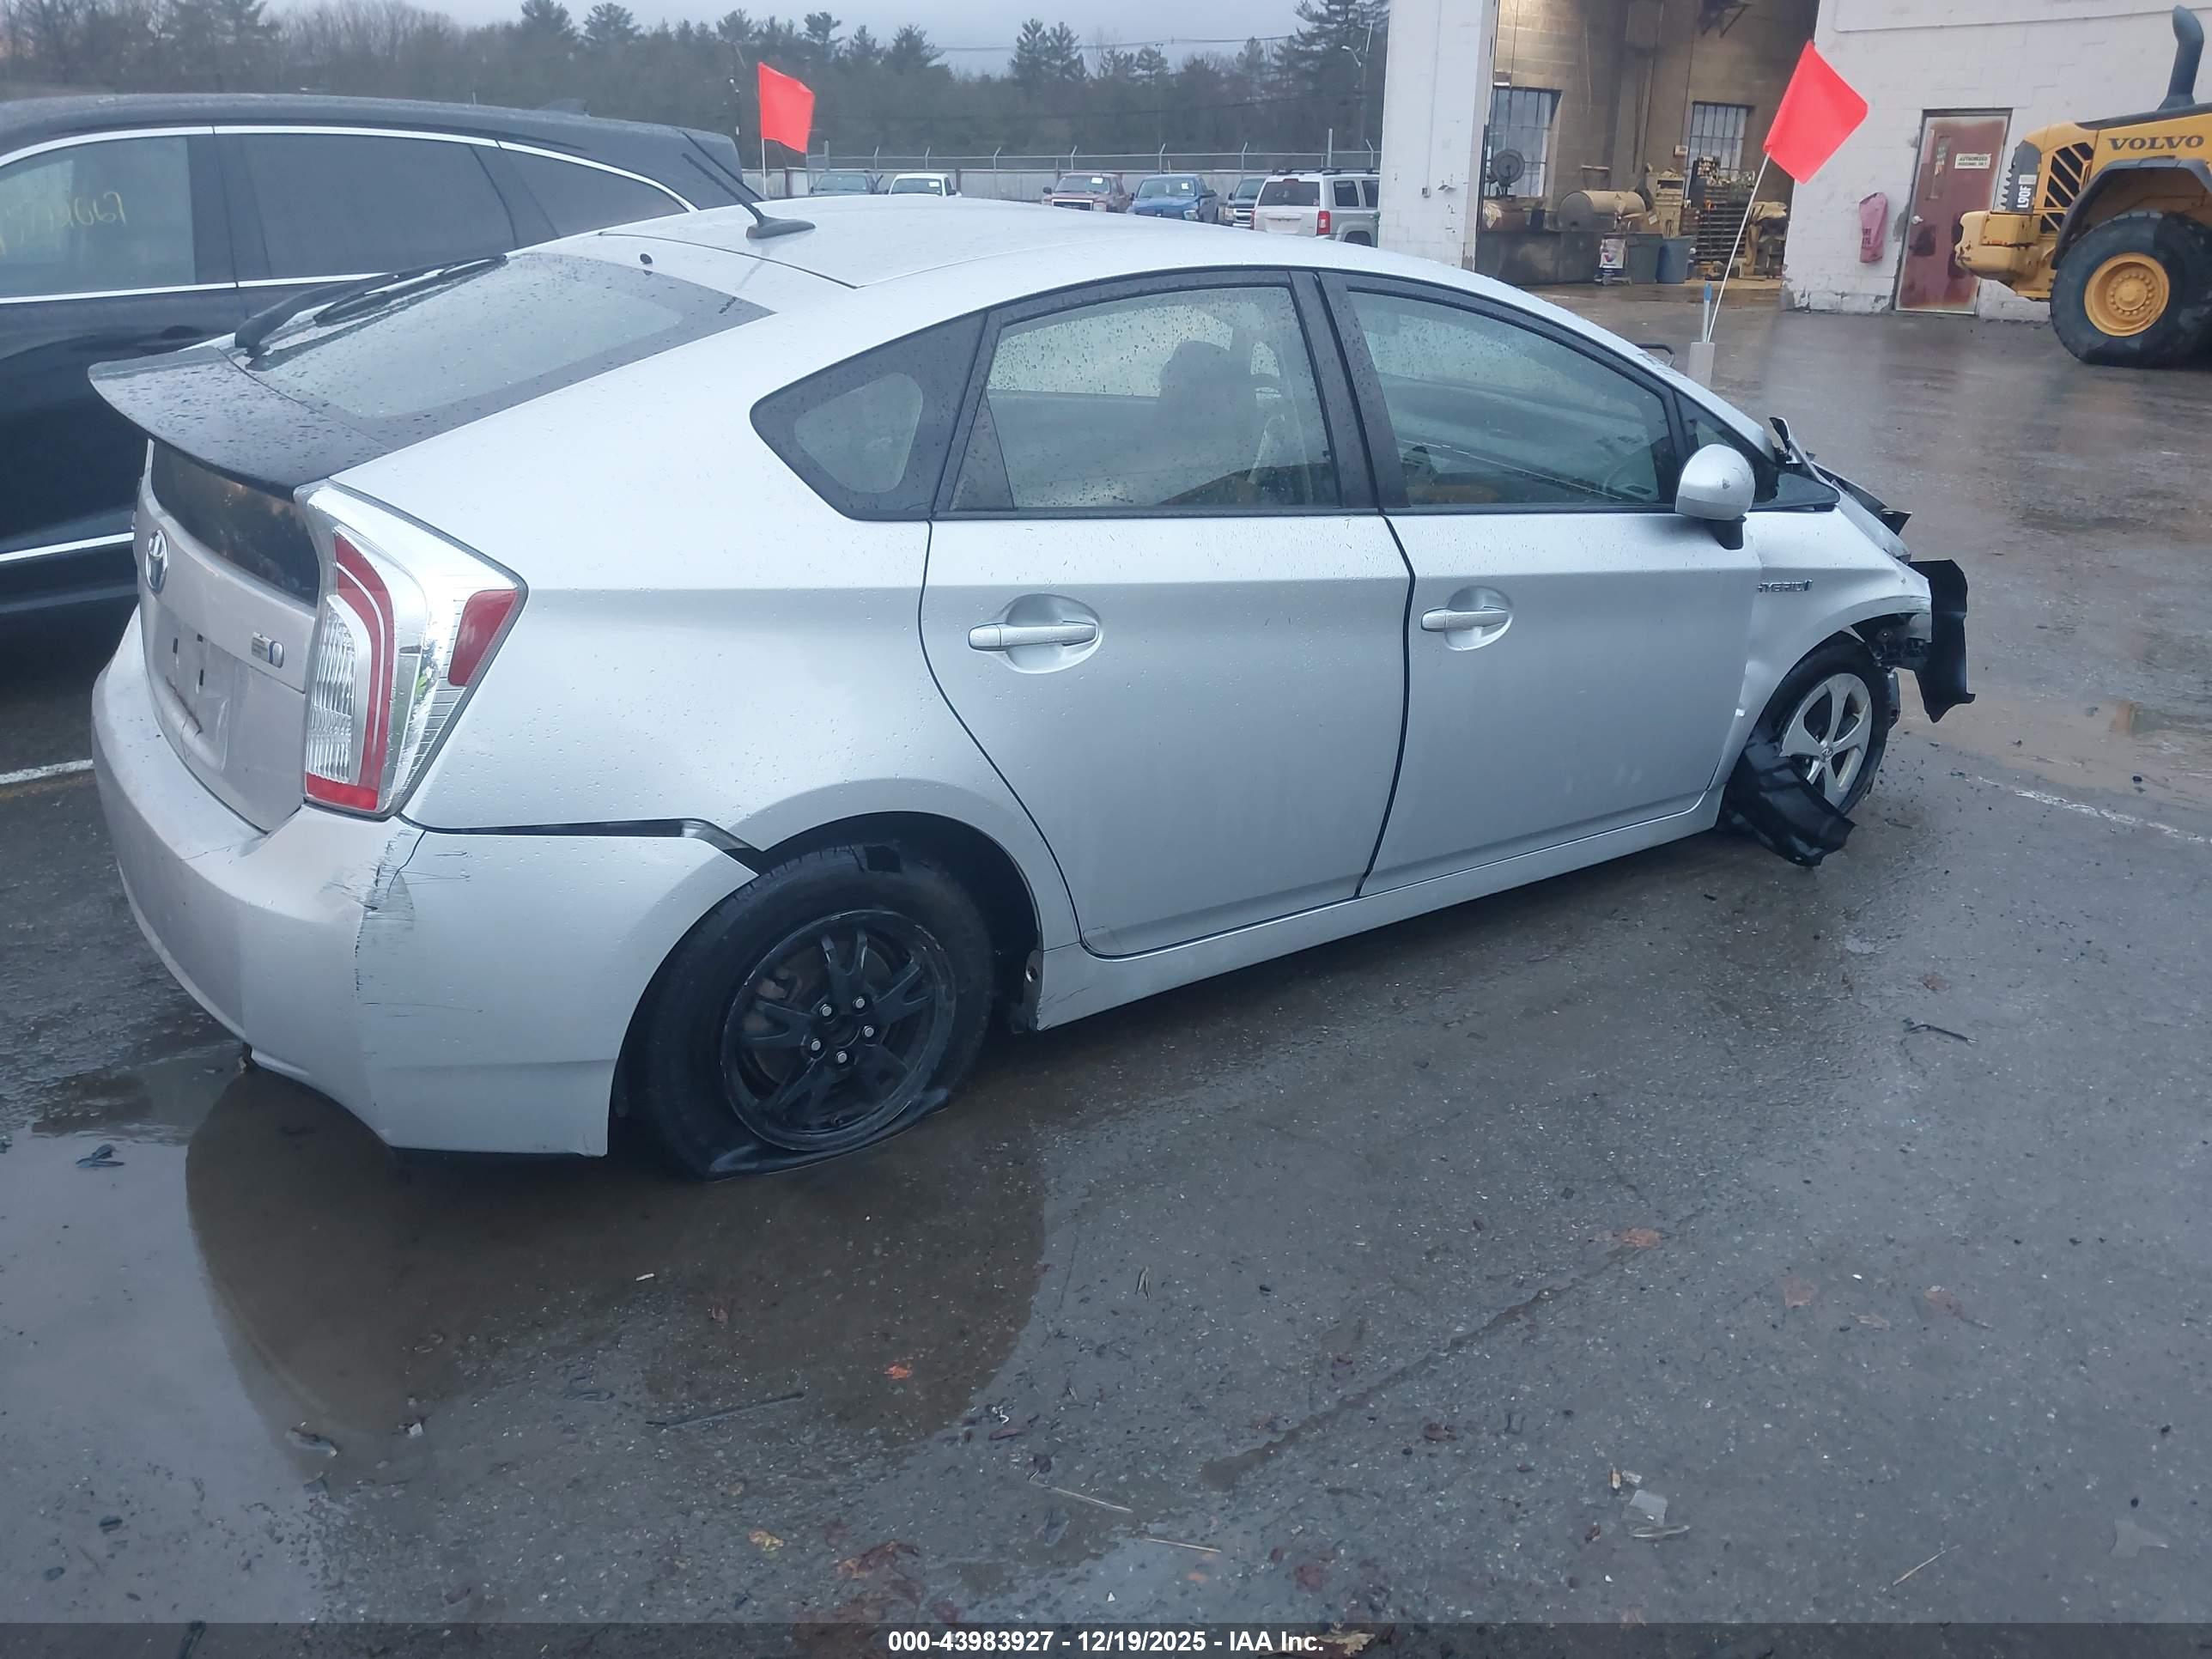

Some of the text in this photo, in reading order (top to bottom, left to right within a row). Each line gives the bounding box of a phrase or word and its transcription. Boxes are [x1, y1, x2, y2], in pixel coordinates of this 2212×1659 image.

[2107, 135, 2204, 151] VOLVO
[2017, 185, 2032, 208] L90F
[1758, 579, 1813, 592] HYBRID
